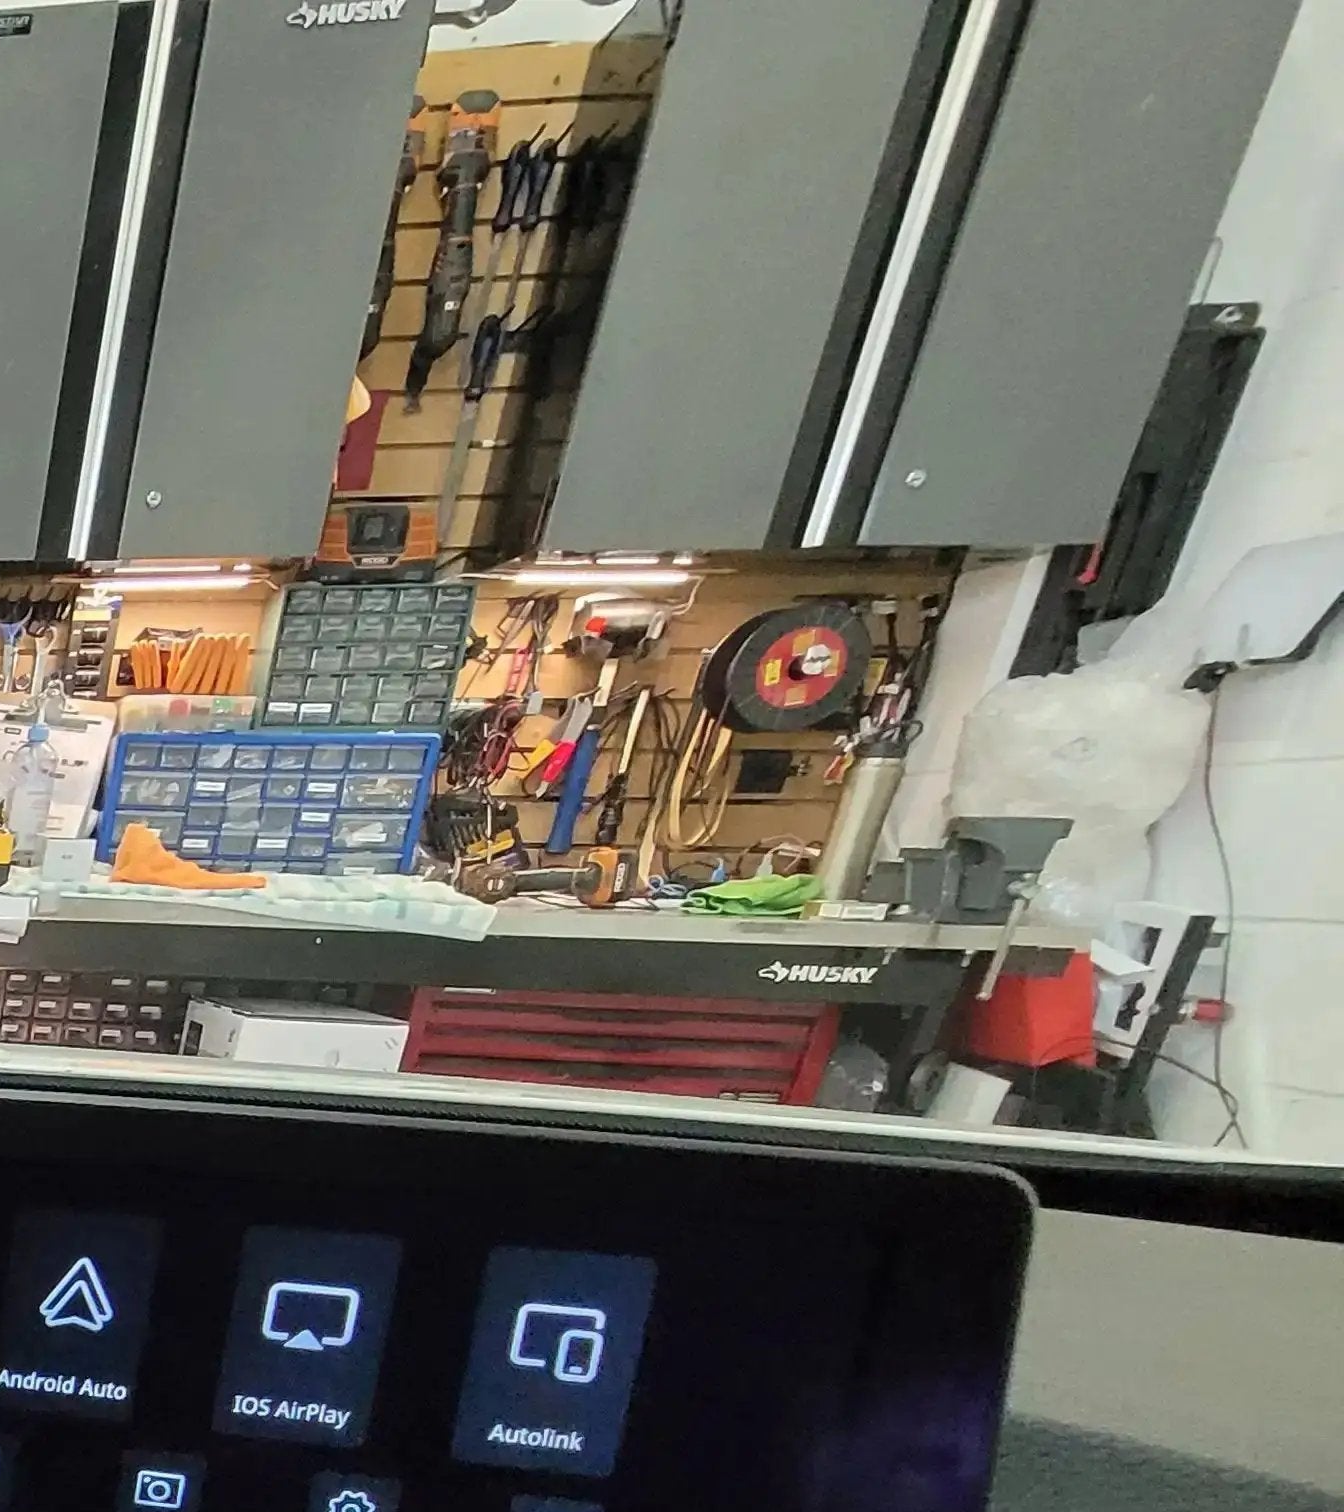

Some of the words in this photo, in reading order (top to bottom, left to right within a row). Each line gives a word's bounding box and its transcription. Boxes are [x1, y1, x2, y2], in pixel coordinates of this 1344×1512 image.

[317, 0, 406, 25] HUSKY
[788, 963, 879, 985] HUSKY
[78, 1376, 128, 1401] Auto
[274, 1399, 351, 1430] AirPlay
[488, 1421, 584, 1454] Autolink
